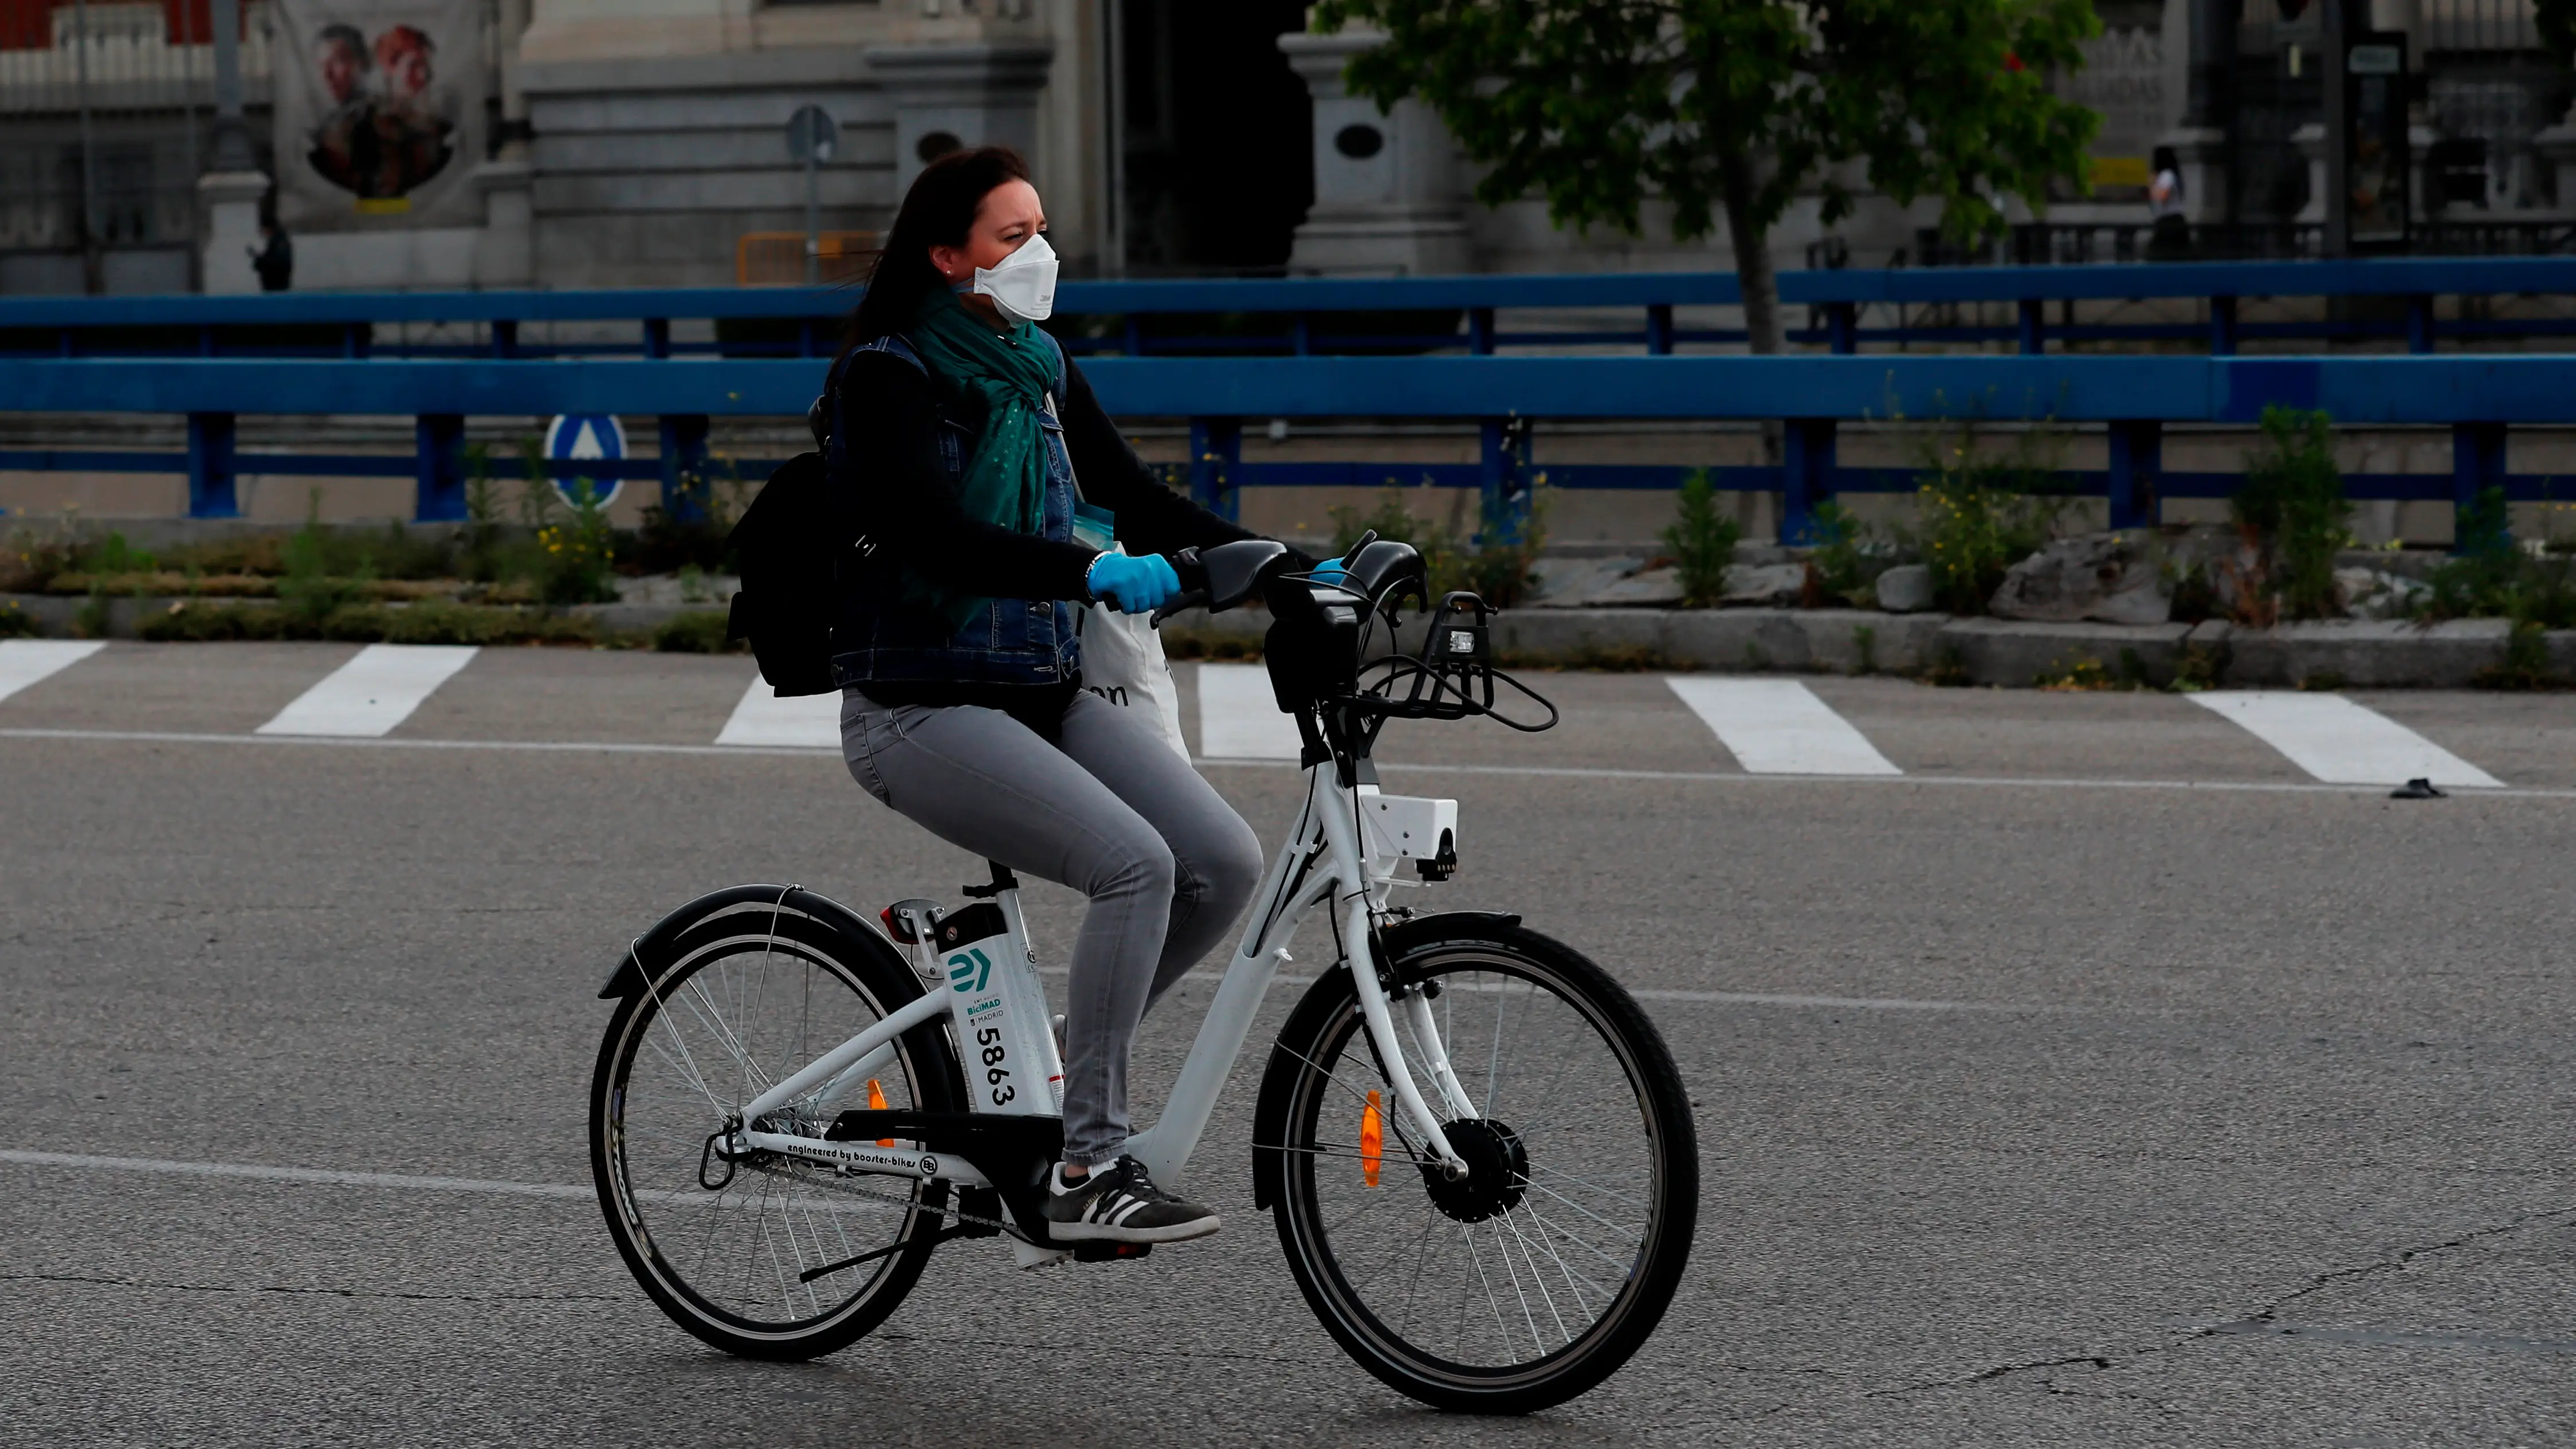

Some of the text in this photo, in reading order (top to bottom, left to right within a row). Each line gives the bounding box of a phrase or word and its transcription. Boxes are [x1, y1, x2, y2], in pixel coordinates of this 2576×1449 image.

[1039, 294, 1052, 303] 3M
[967, 999, 1000, 1015] BiciMAD
[978, 1010, 1004, 1023] MADRID
[977, 1027, 1015, 1106] 5863
[787, 1145, 916, 1168] engineered by booster-bikes
